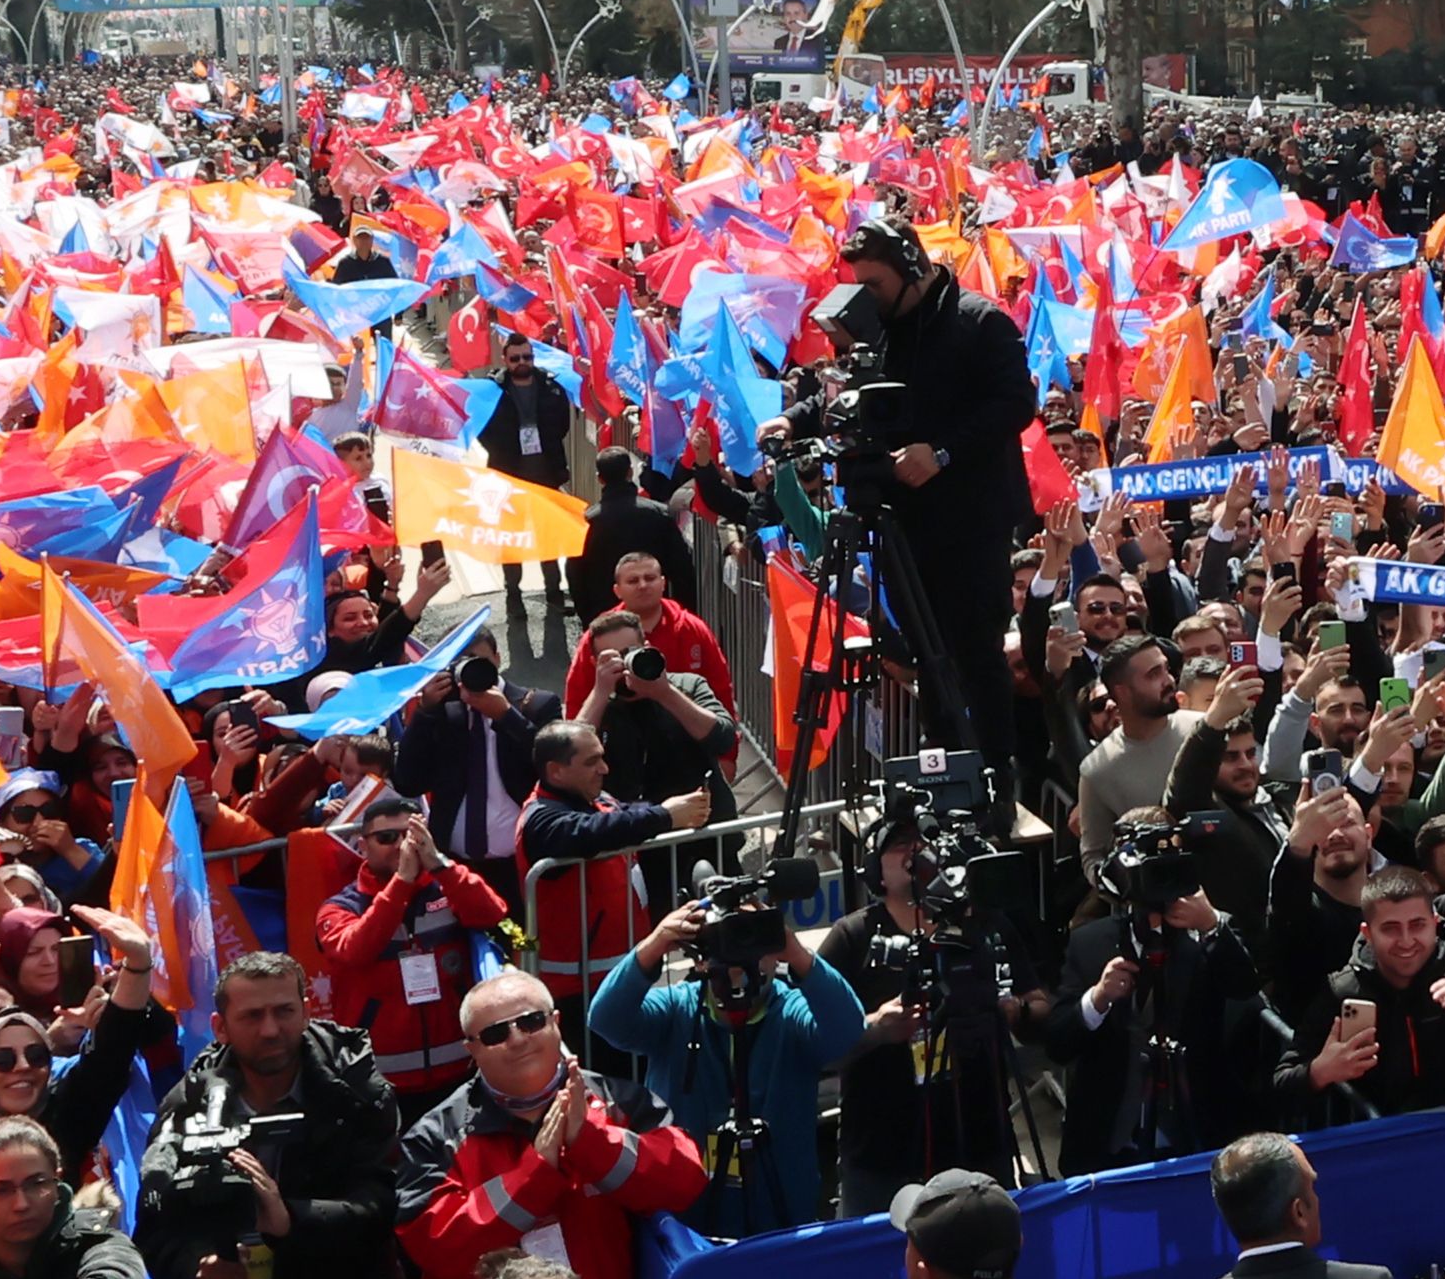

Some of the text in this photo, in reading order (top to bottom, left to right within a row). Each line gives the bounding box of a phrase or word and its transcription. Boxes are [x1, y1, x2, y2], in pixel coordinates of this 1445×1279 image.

[1122, 473, 1154, 498] AK
[434, 516, 465, 538] AK
[1384, 570, 1422, 596] AK
[926, 753, 940, 769] 3
[917, 774, 952, 784] SONY
